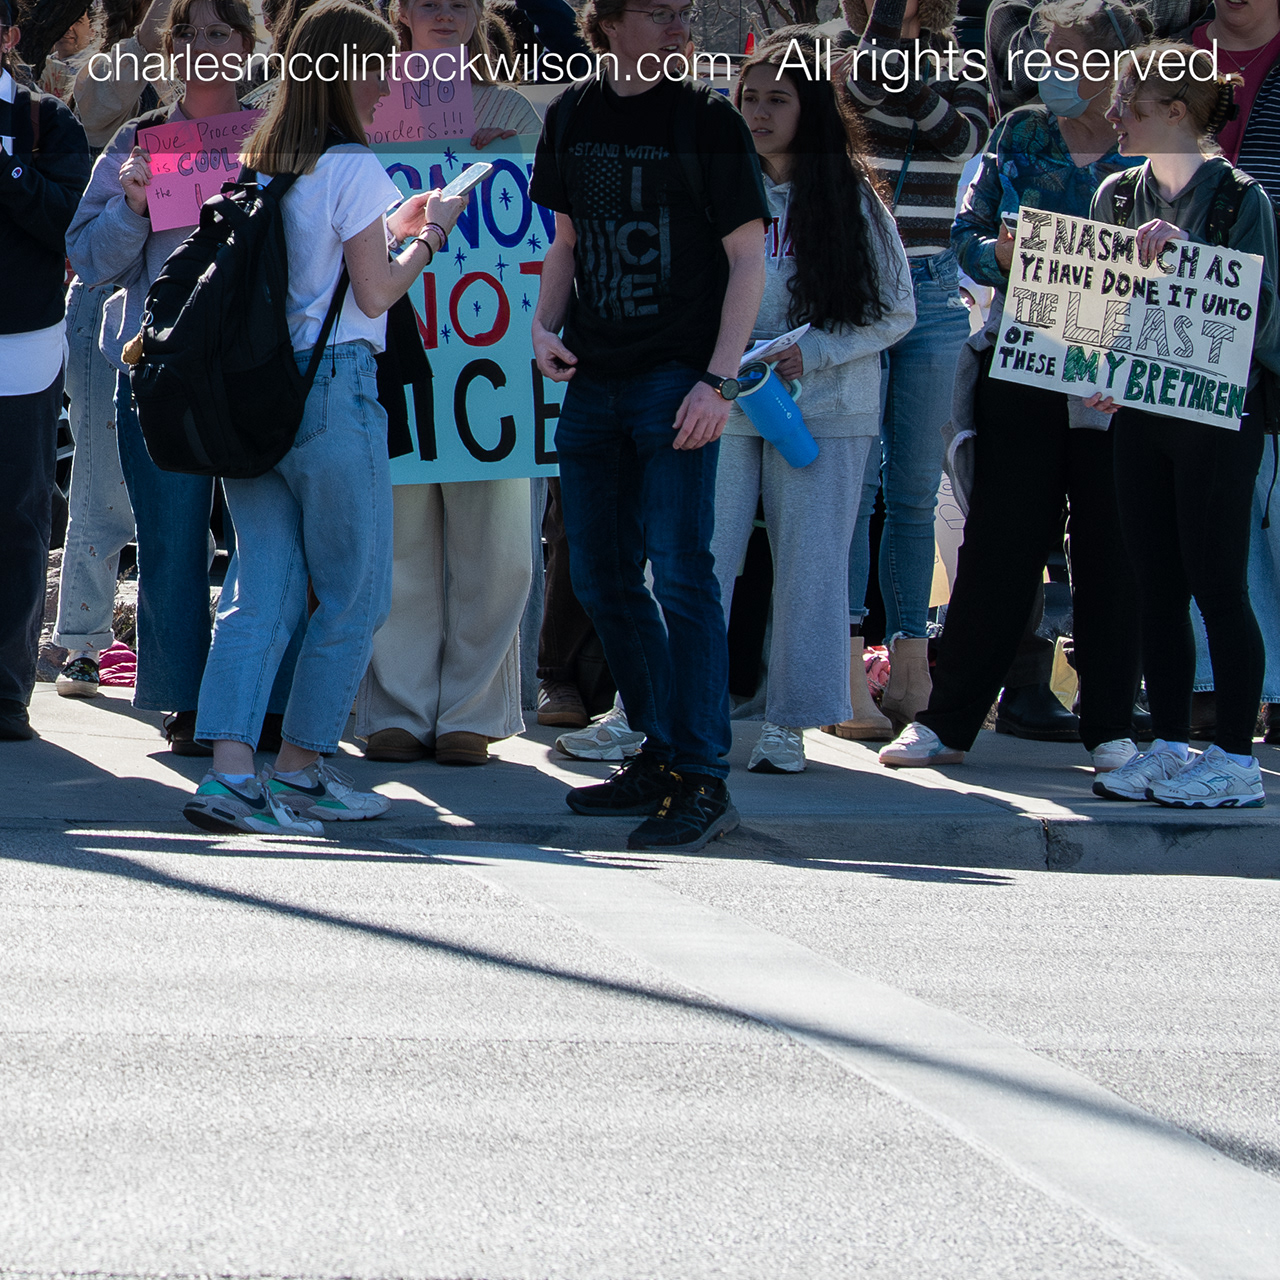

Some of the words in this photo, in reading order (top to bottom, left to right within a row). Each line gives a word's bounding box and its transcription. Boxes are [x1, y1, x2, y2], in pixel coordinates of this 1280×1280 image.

[402, 79, 456, 110] NO
[144, 133, 186, 155] Due
[574, 141, 620, 157] STAND
[624, 143, 663, 160] WITH
[157, 163, 171, 173] is
[177, 147, 239, 177] COOL
[155, 187, 172, 200] the
[1020, 251, 1045, 284] YE
[1048, 259, 1094, 290] HAVE
[1101, 268, 1161, 307] DONE
[1167, 283, 1198, 309] IT
[1201, 292, 1253, 322] UNTO
[1204, 254, 1243, 289] AS
[1004, 325, 1035, 346] OF
[1012, 286, 1059, 325] THE
[1063, 290, 1238, 364] LEAST
[999, 345, 1057, 376] THESE
[1062, 344, 1126, 389] MY
[1123, 358, 1248, 420] BRETHREN
[411, 358, 561, 466] ICE
